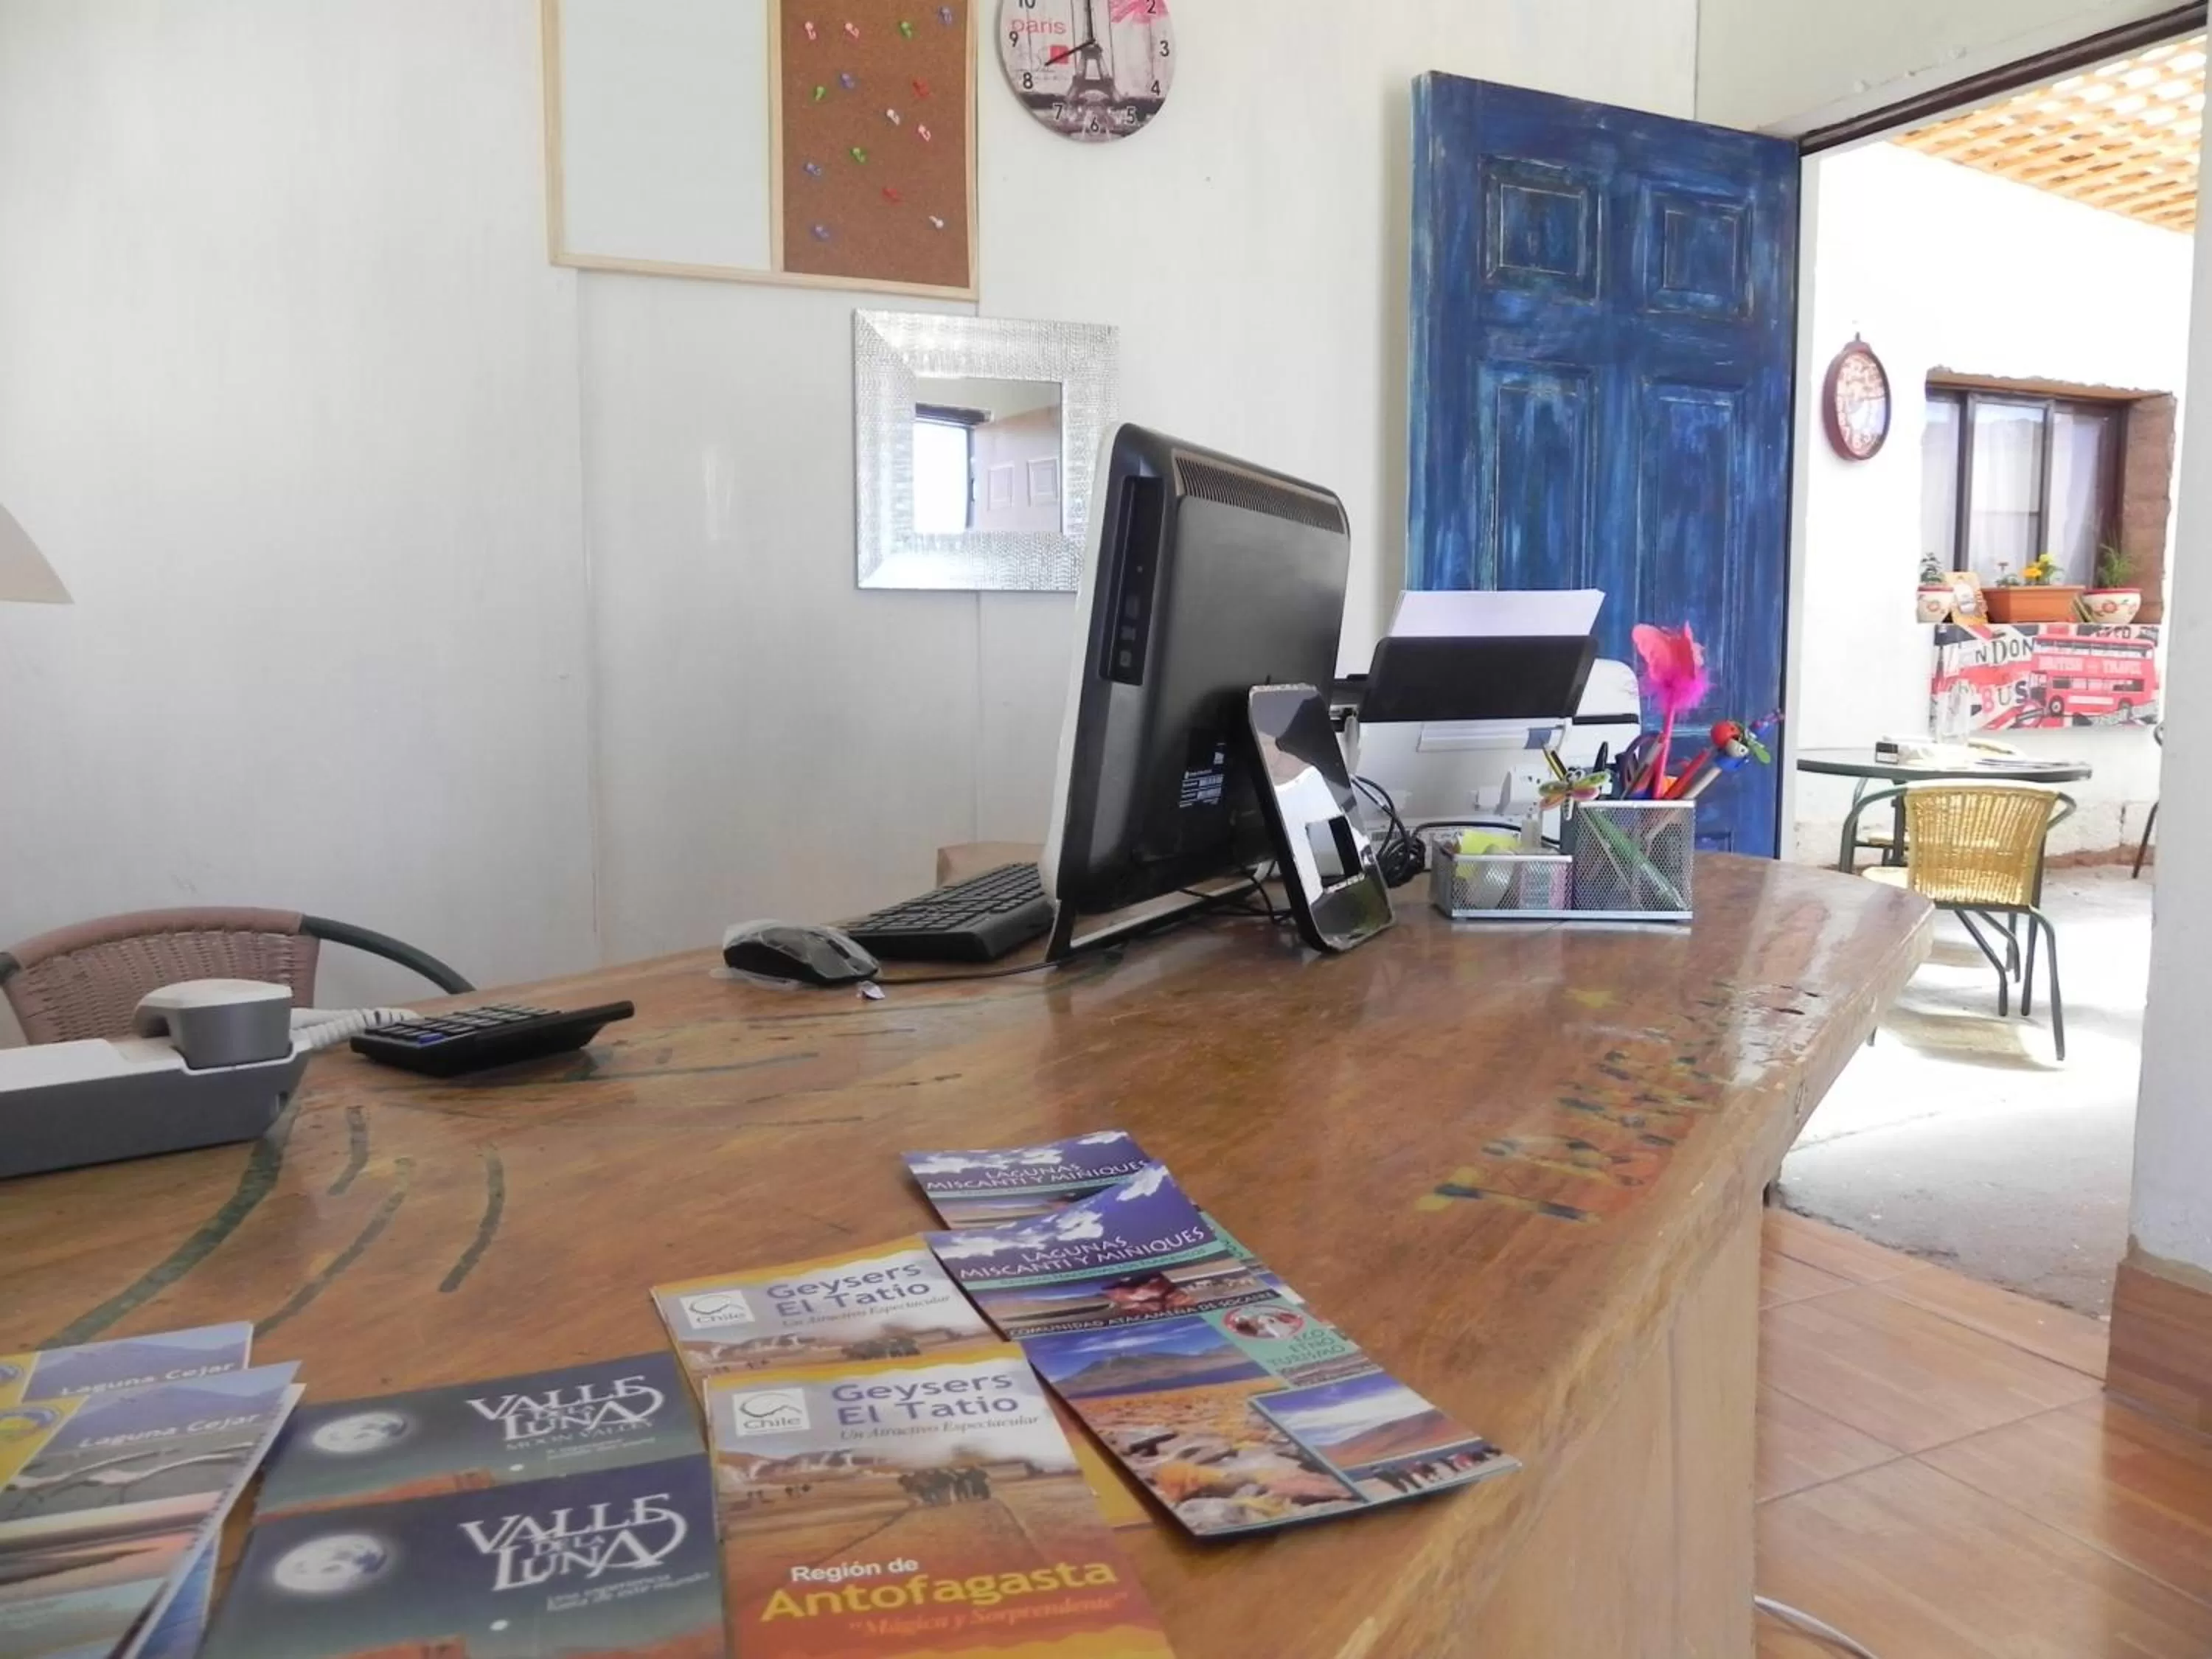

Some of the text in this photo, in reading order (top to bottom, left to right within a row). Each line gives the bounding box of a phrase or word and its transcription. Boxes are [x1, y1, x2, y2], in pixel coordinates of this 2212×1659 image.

[1147, 0, 1156, 14] 2
[1011, 17, 1067, 35] paris
[1009, 31, 1019, 48] 9
[1160, 40, 1169, 57] 3
[1023, 72, 1033, 90] 8
[1151, 80, 1161, 96] 4
[1054, 104, 1063, 120] 7
[1126, 107, 1136, 125] 5
[1090, 116, 1099, 133] 6
[1982, 680, 2029, 714] BUS
[985, 1163, 1082, 1180] LAGUNAS
[926, 1177, 1026, 1190] MISCANTI
[1029, 1175, 1044, 1186] Y
[1022, 1236, 1127, 1264] LAGUNAS
[960, 1258, 1071, 1280] MISCANTI
[1074, 1256, 1088, 1269] Y
[768, 1262, 921, 1302] Geysers
[776, 1281, 931, 1318] El Tatio
[695, 1311, 746, 1325] Chile
[61, 1376, 155, 1396] Laguna
[832, 1374, 1013, 1402] Geysers
[466, 1375, 647, 1420] VALLE
[504, 1392, 664, 1441] LUNA
[838, 1396, 1019, 1426] El Tatio
[743, 1413, 801, 1430] Chile
[79, 1427, 178, 1448] Laguna
[840, 1429, 865, 1440] Un
[459, 1493, 671, 1554] VALLE
[491, 1516, 687, 1592] LUNA
[790, 1557, 919, 1583] Región de
[760, 1561, 1119, 1622] Antofagasta
